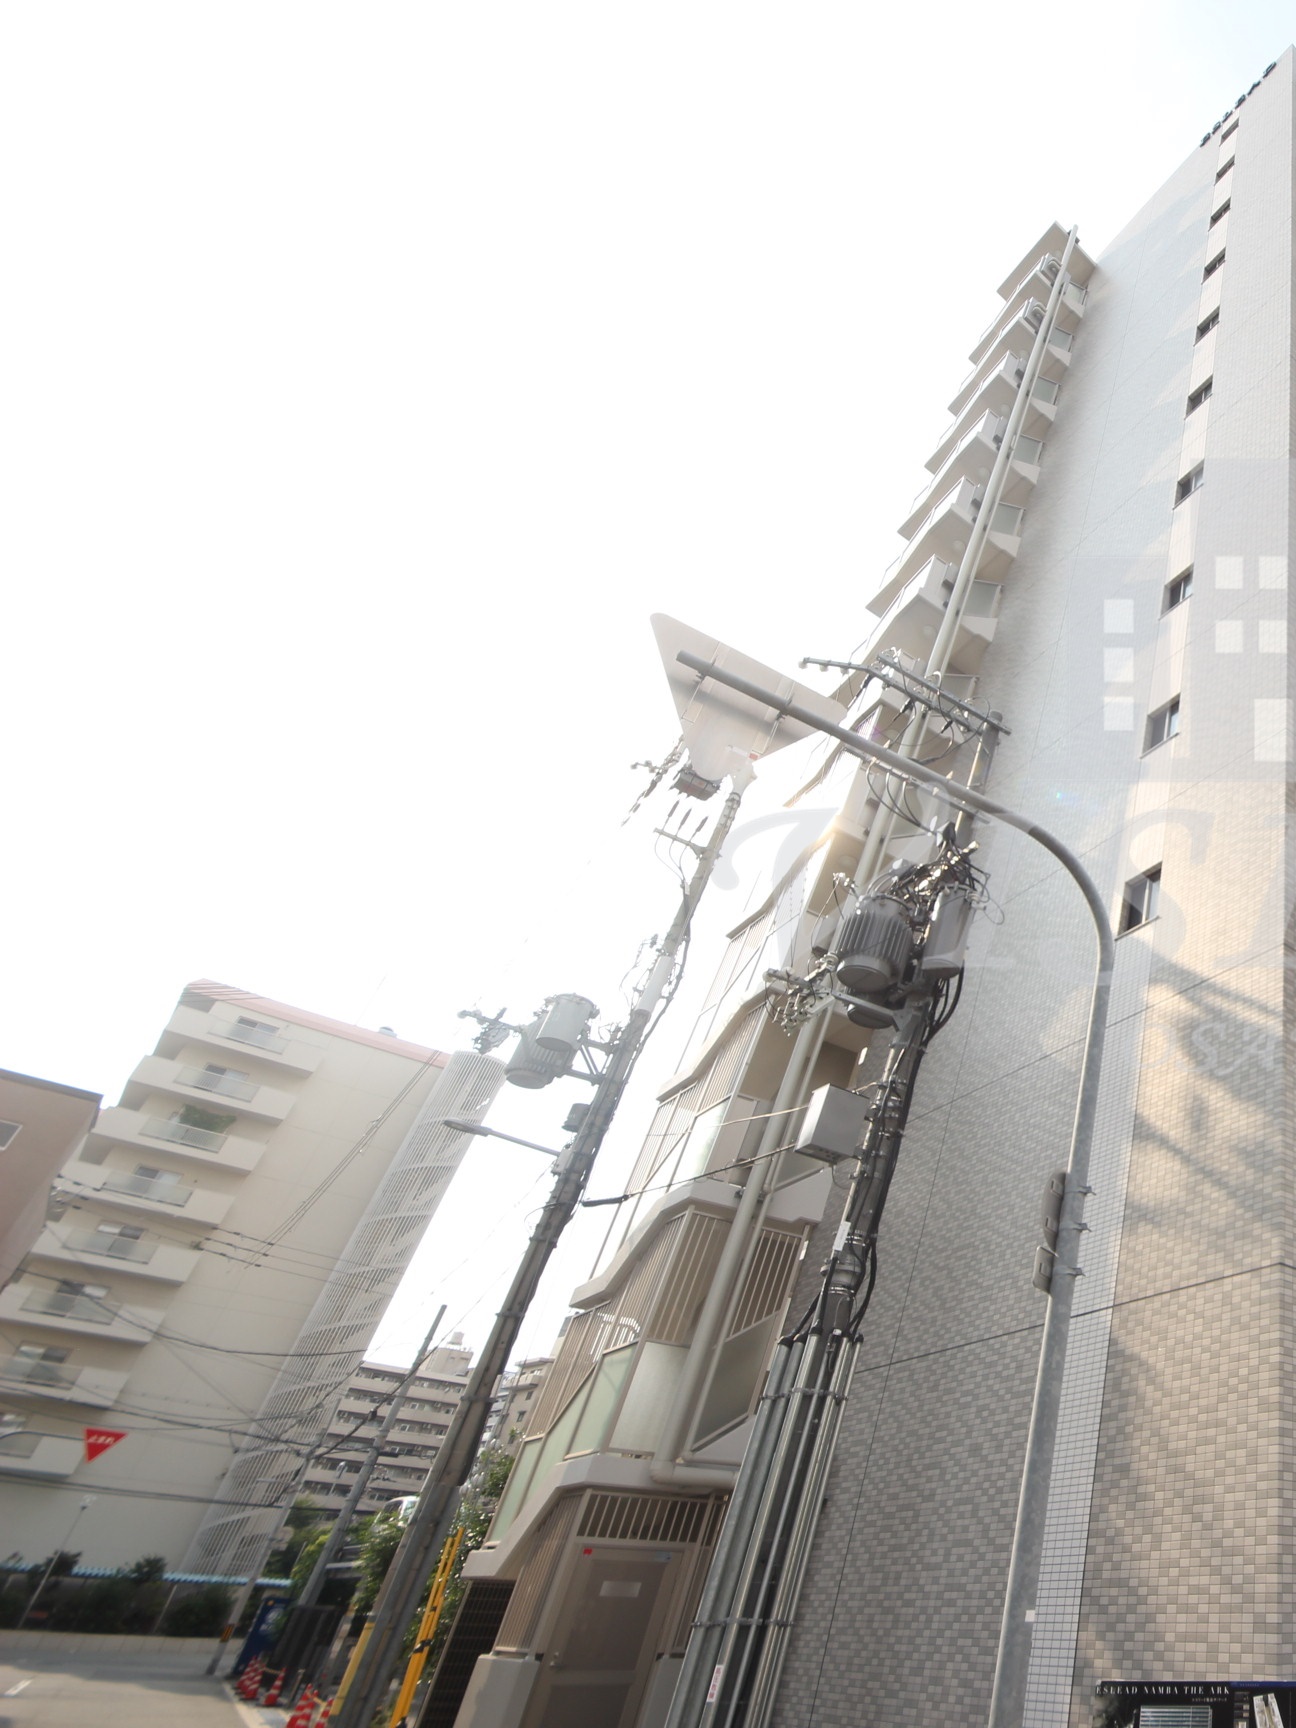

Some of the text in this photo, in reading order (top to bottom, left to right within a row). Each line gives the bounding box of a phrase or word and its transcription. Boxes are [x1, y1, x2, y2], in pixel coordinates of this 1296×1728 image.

[1096, 1685, 1139, 1695] ESLEAD
[1144, 1685, 1178, 1695] NAMBA
[1183, 1685, 1204, 1695] THE
[1210, 1685, 1230, 1695] ARK
